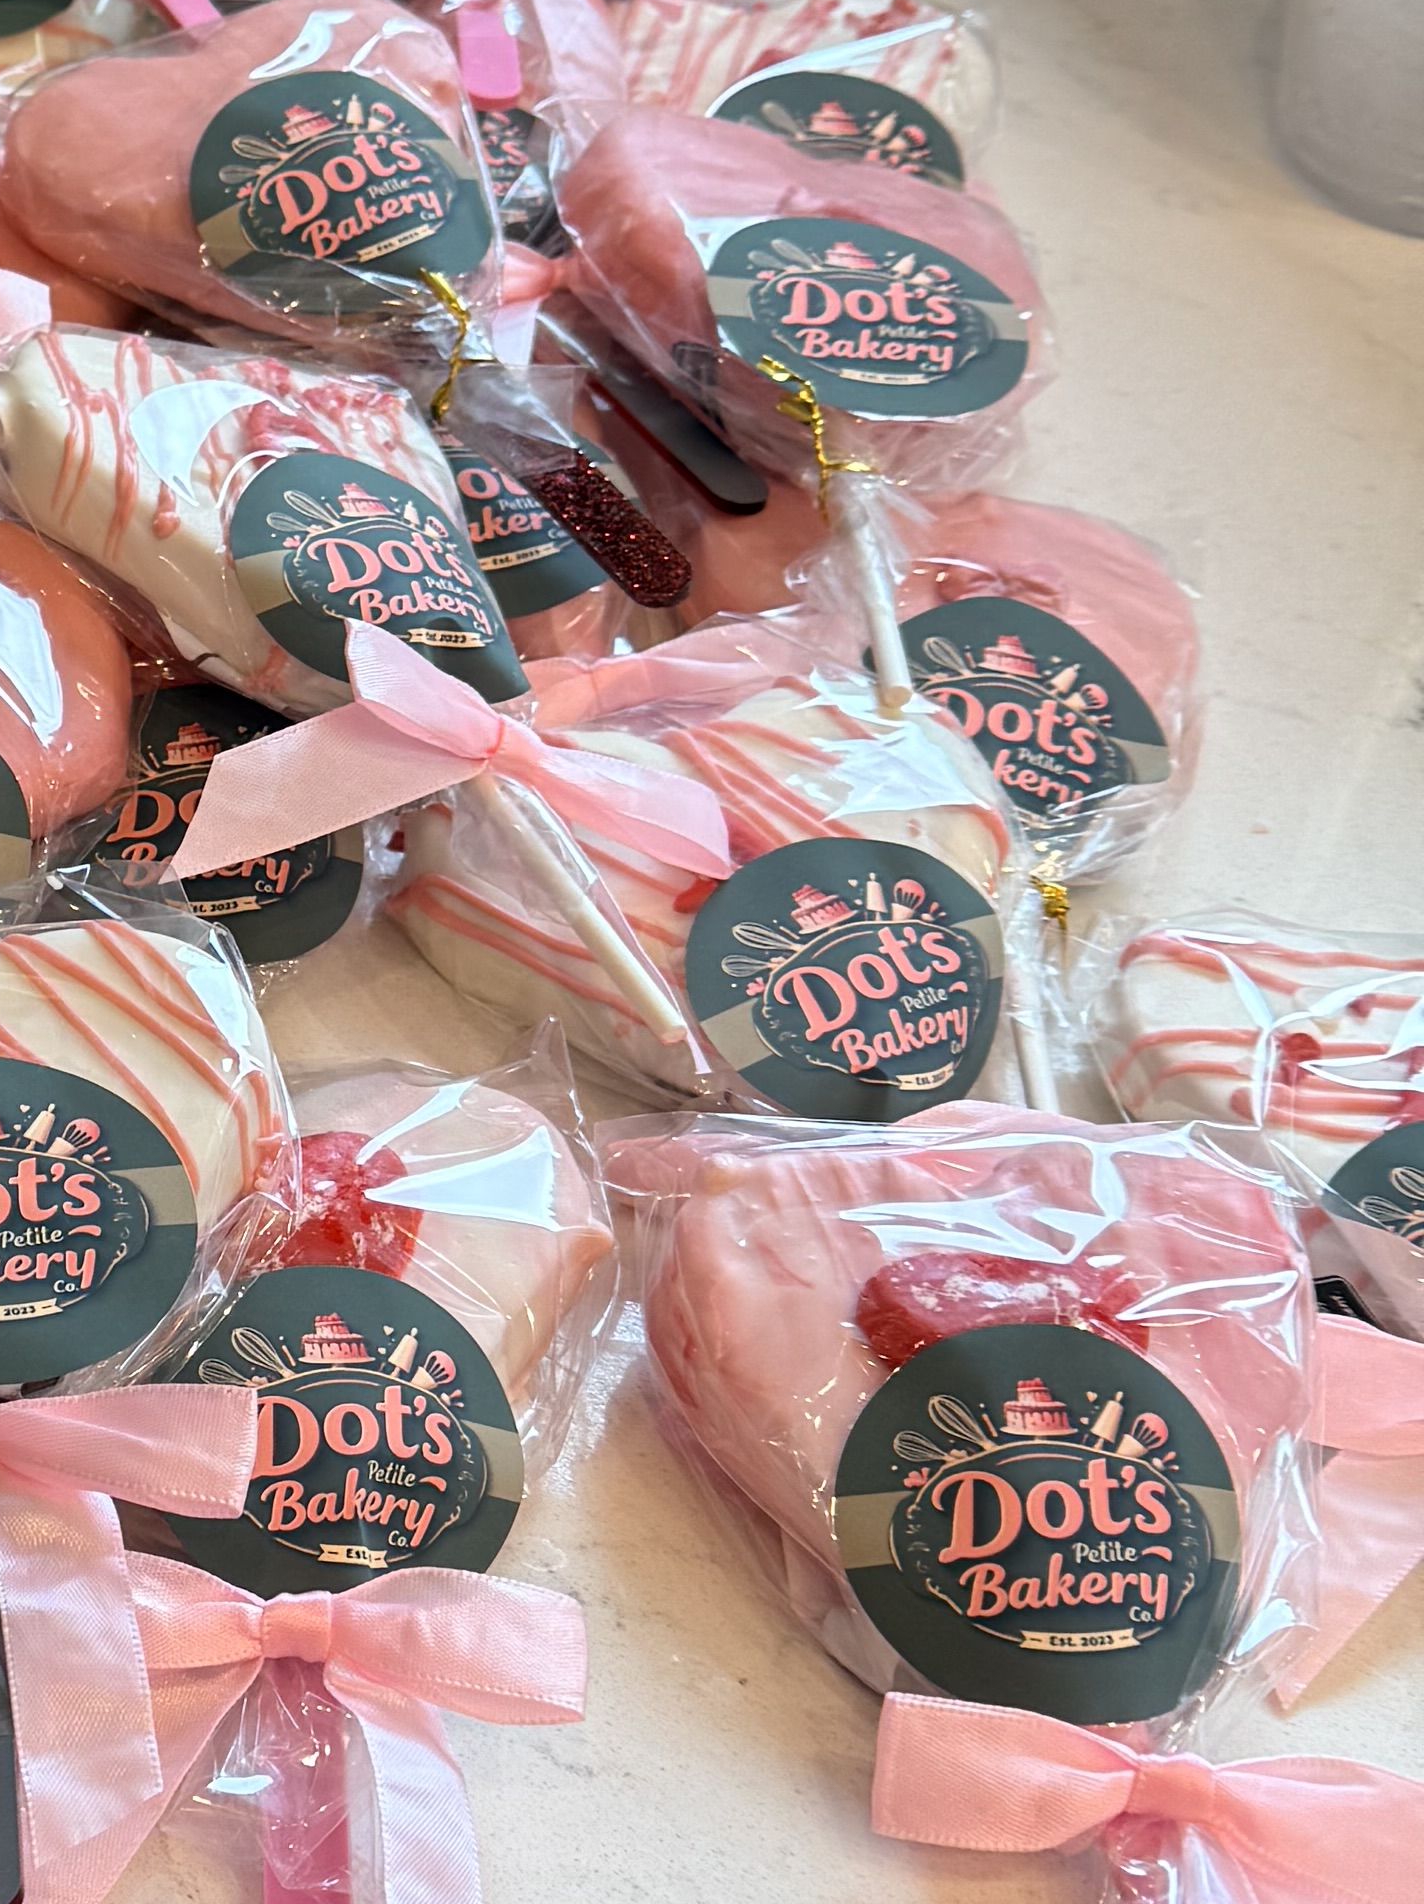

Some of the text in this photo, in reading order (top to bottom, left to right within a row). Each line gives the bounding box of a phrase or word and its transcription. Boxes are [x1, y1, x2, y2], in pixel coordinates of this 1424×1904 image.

[259, 135, 421, 235] Dot's
[301, 190, 443, 259] Bakery
[777, 278, 956, 324] Dot's
[795, 328, 953, 371] Bakery
[307, 533, 473, 593] Dot's
[349, 588, 490, 628] Bakery
[774, 927, 961, 1042] Dot's
[832, 1007, 969, 1075] Bakery
[52, 1278, 81, 1295] Co.
[4, 1304, 37, 1318] 2023
[367, 1459, 417, 1487] Petite
[259, 1469, 437, 1549] Bakery
[931, 1457, 1173, 1564] Dot's
[387, 1529, 411, 1548] Co.
[1072, 1542, 1139, 1566] Petite
[960, 1553, 1170, 1622] Bakery
[1130, 1606, 1154, 1623] Co.
[1080, 1632, 1115, 1648] 2023
